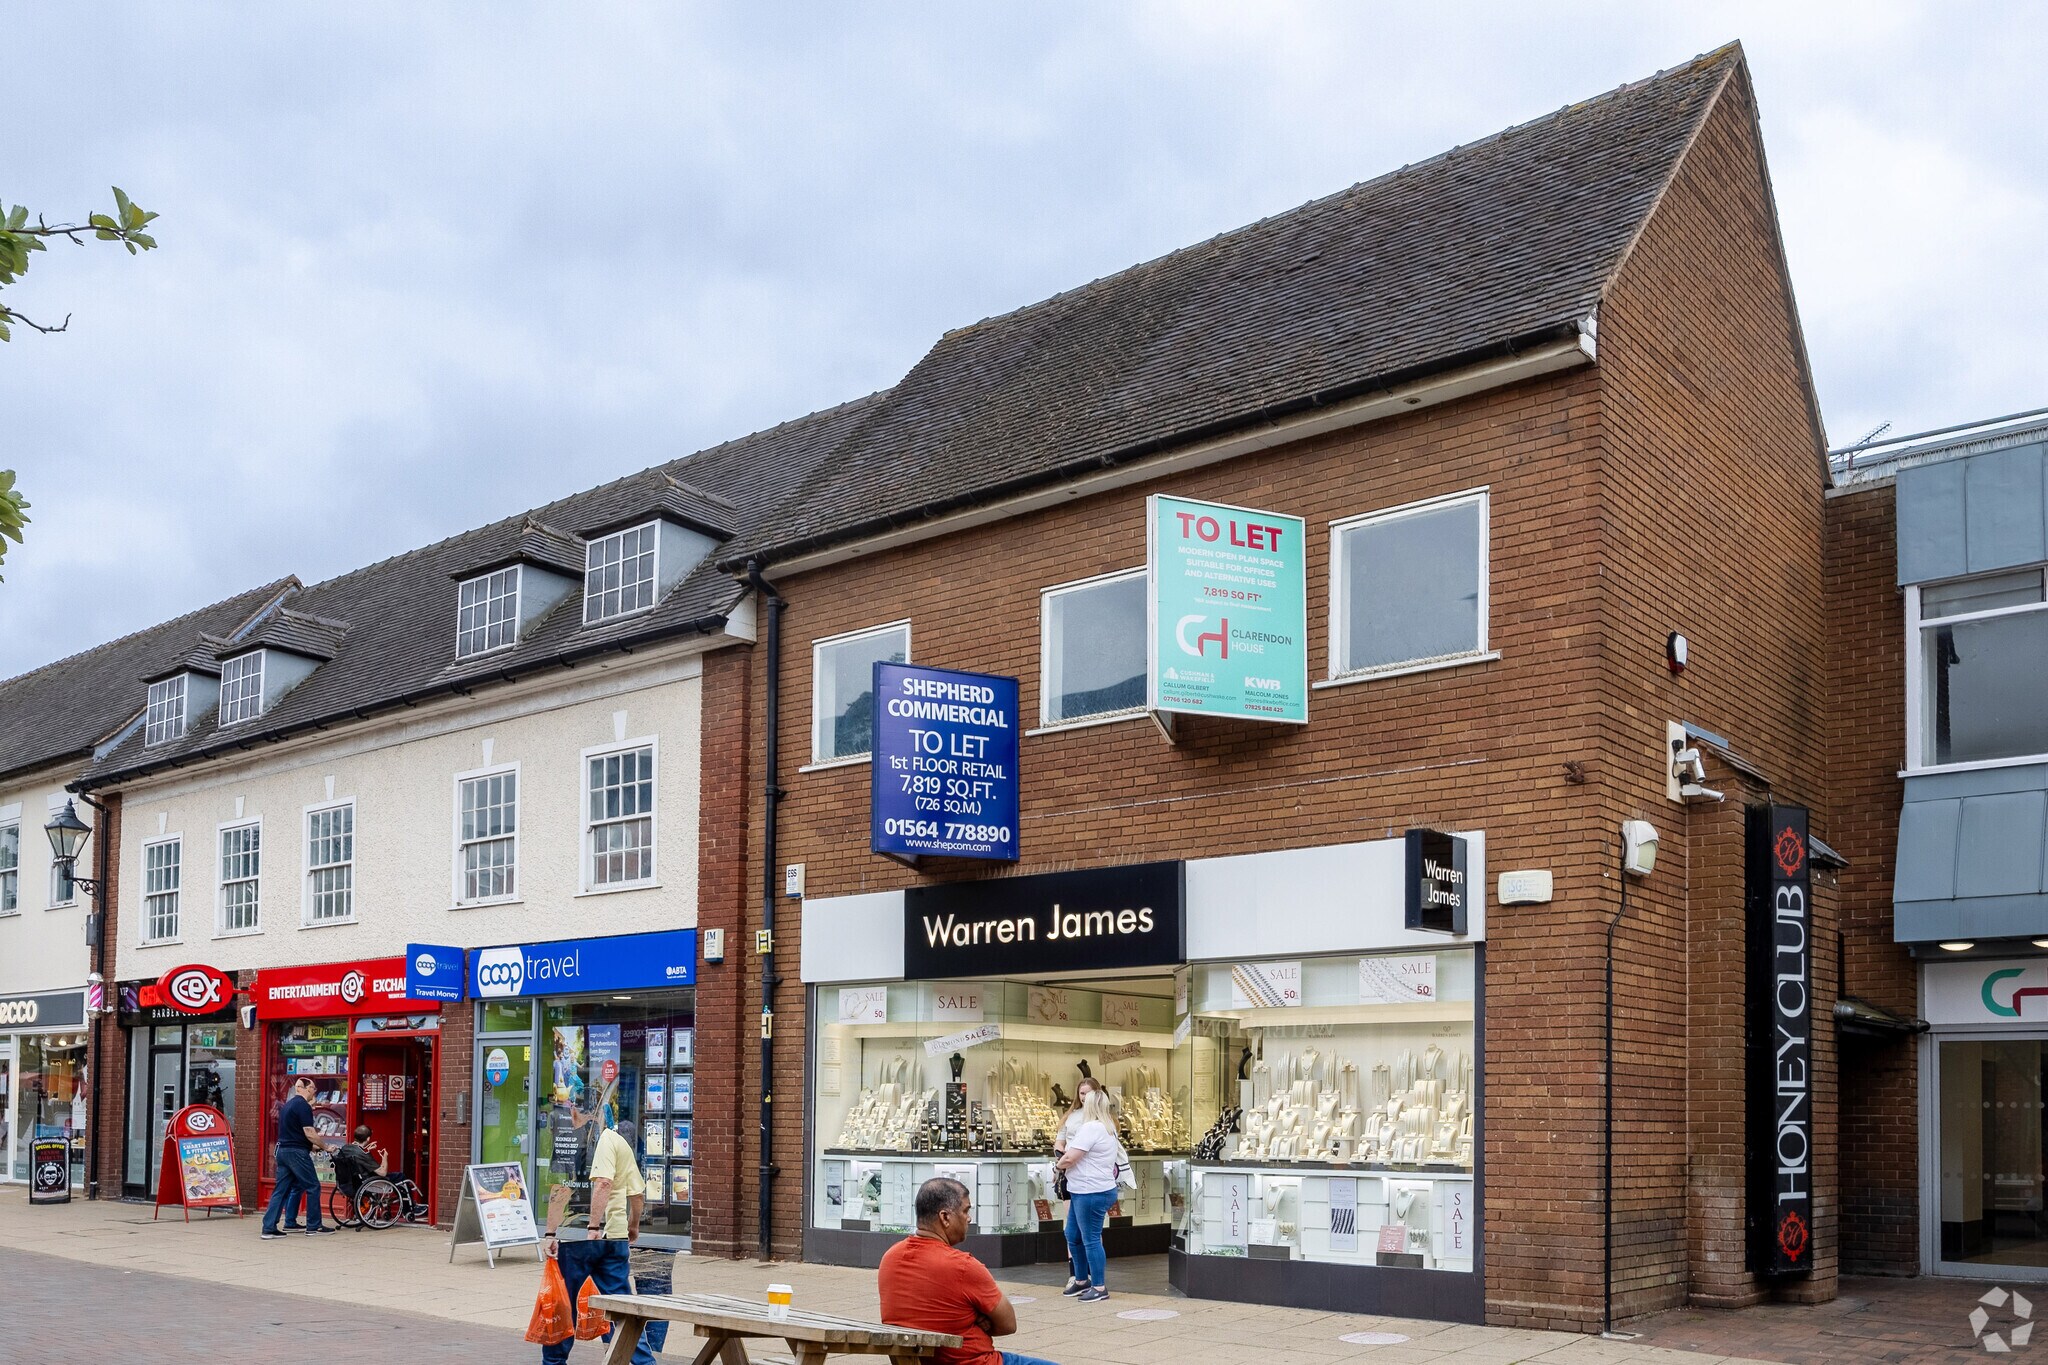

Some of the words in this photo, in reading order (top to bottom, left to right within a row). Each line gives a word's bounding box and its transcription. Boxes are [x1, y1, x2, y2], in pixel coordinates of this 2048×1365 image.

[1176, 511, 1220, 542] TO
[1229, 520, 1283, 552] LET
[1178, 546, 1214, 557] MODERN
[1215, 551, 1237, 560] OPEN
[1238, 554, 1259, 564] PLAN
[1260, 557, 1285, 568] SPACE
[1186, 558, 1225, 570] SUITABLE
[1225, 563, 1242, 572] FOR
[1243, 566, 1275, 577] OFFICES
[1184, 569, 1203, 577] AND
[1204, 572, 1256, 585] ALTERNATIVE
[1257, 578, 1277, 588] USES
[1204, 586, 1228, 598] 7,819
[1231, 591, 1245, 600] SQ
[1231, 629, 1292, 646] CLARENDON
[1231, 641, 1264, 654] HOUSE
[902, 678, 995, 704] SHEPHERD
[1244, 676, 1281, 690] KWB
[887, 699, 1008, 728] COMMERCIAL
[908, 729, 943, 754] TO
[950, 733, 989, 759] LET
[889, 755, 908, 770] 1st
[912, 757, 958, 774] FLOOR
[962, 763, 1007, 780] RETAIL
[900, 774, 941, 796] 7,819
[946, 778, 997, 800] SQ.FT.
[915, 796, 940, 811] (726
[943, 800, 982, 816] SQ.M.)
[884, 818, 939, 838] 01564
[944, 822, 1010, 843] 778890
[905, 838, 992, 853] www.shepcom.com
[1424, 858, 1463, 884] Warren
[1427, 883, 1461, 907] James
[922, 912, 1035, 948] Warren
[1046, 903, 1154, 940] James
[1776, 884, 1804, 1019] CLUB
[437, 962, 459, 971] travel
[526, 948, 580, 980] travel
[1401, 962, 1431, 976] SALE
[1270, 967, 1297, 981] SALE
[268, 982, 341, 1000] ENTERTAINMENT
[415, 988, 436, 997] Travel
[436, 990, 459, 999] Money
[865, 991, 885, 1002] SALE
[938, 995, 978, 1009] SALE
[964, 1029, 988, 1041] SALE
[1777, 1023, 1807, 1207] HONEY
[201, 1140, 226, 1148] WATCHES
[193, 1150, 229, 1165] CASH
[562, 1180, 581, 1189] Follow
[1230, 1184, 1240, 1237] SALE
[1452, 1193, 1463, 1249] SALE
